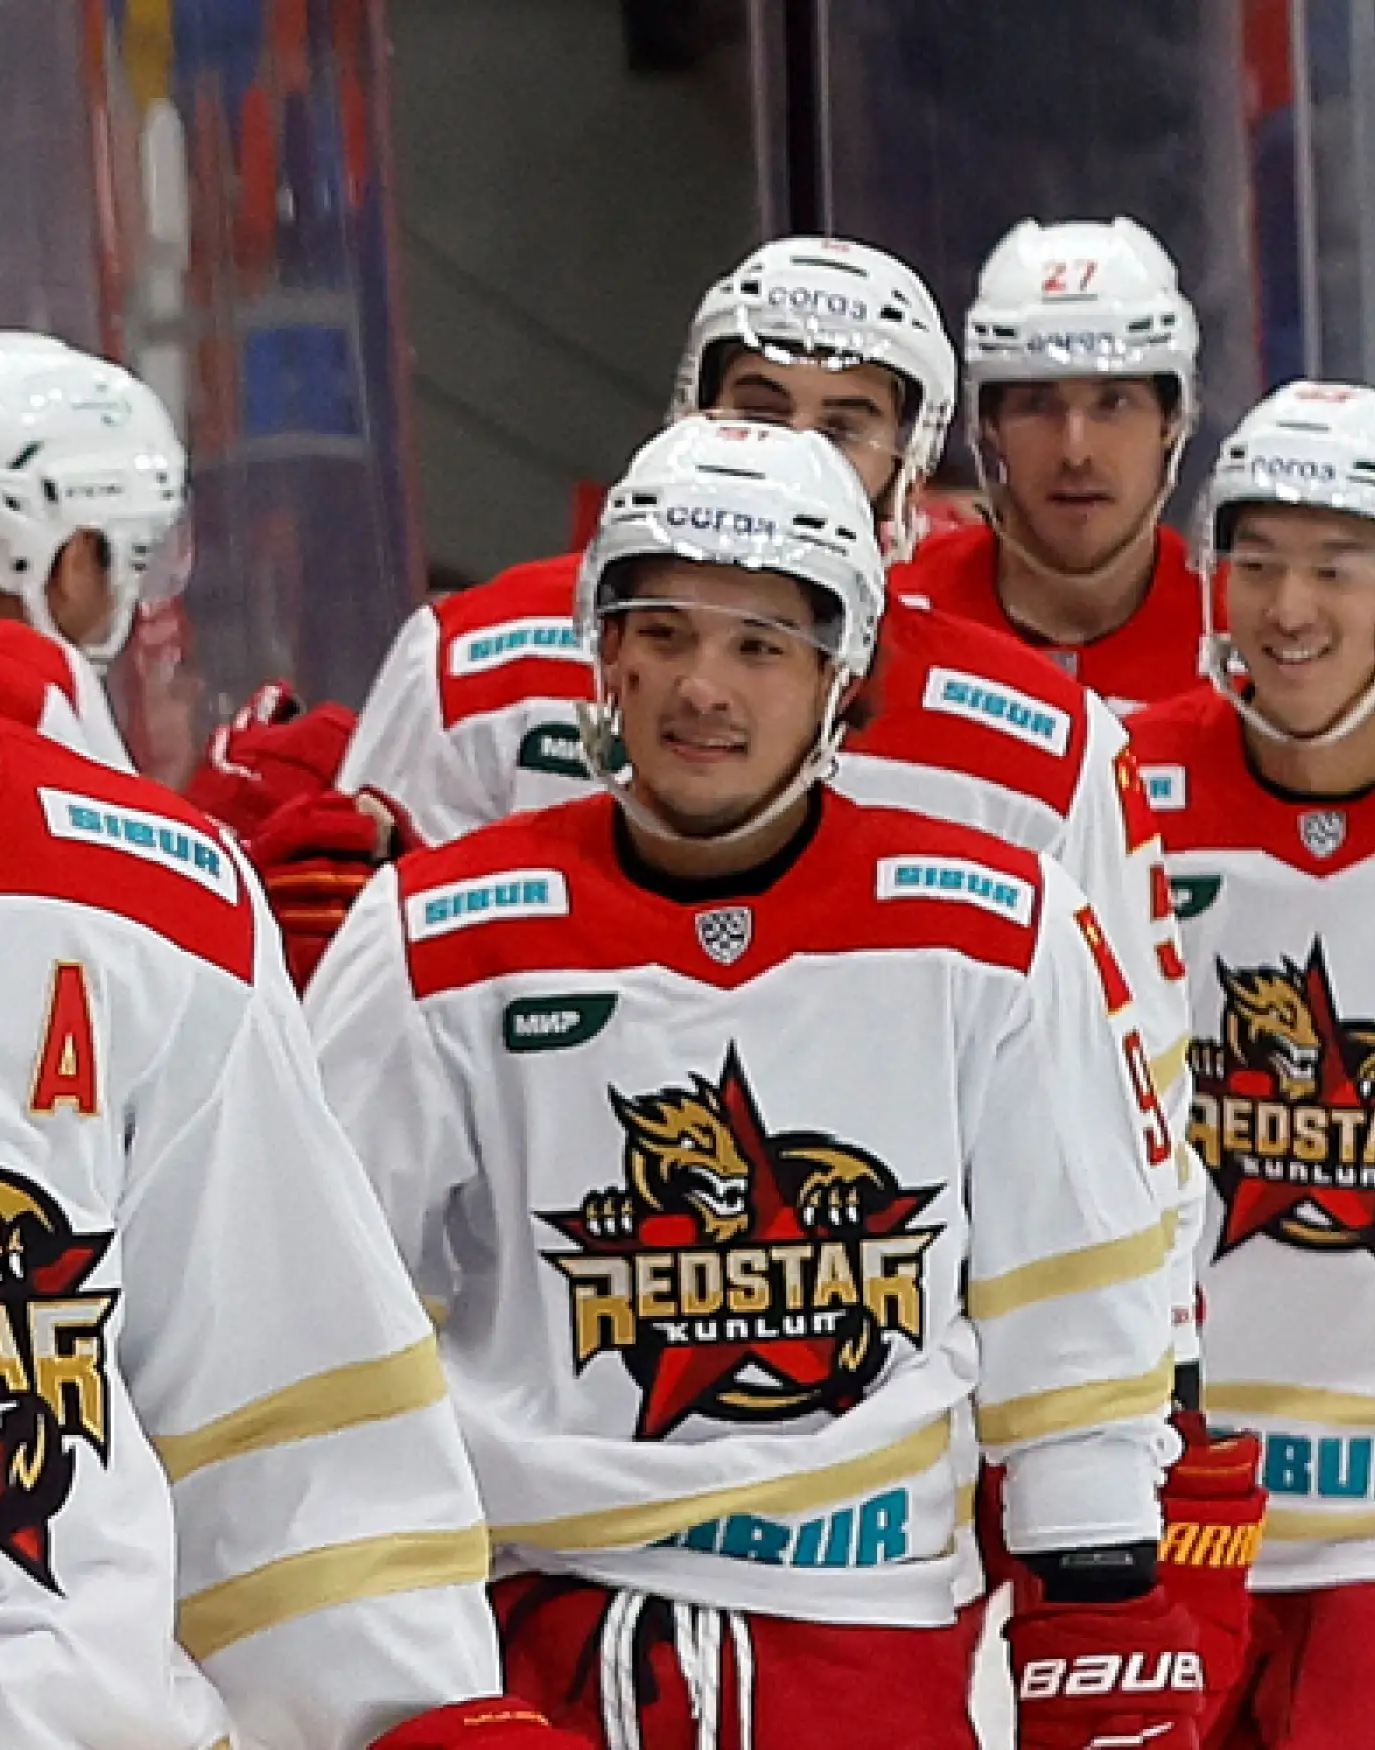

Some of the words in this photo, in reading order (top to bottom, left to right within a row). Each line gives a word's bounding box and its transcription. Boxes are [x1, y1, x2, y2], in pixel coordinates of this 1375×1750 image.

[1040, 259, 1098, 293] 27
[942, 679, 1057, 739] SIBUR
[67, 804, 221, 879] SIBUR
[424, 878, 550, 925] SIBUR
[894, 864, 1021, 909] SIBUR
[28, 958, 100, 1118] A
[557, 1230, 936, 1361] REDSTAR
[652, 1308, 849, 1343] KUNLUN
